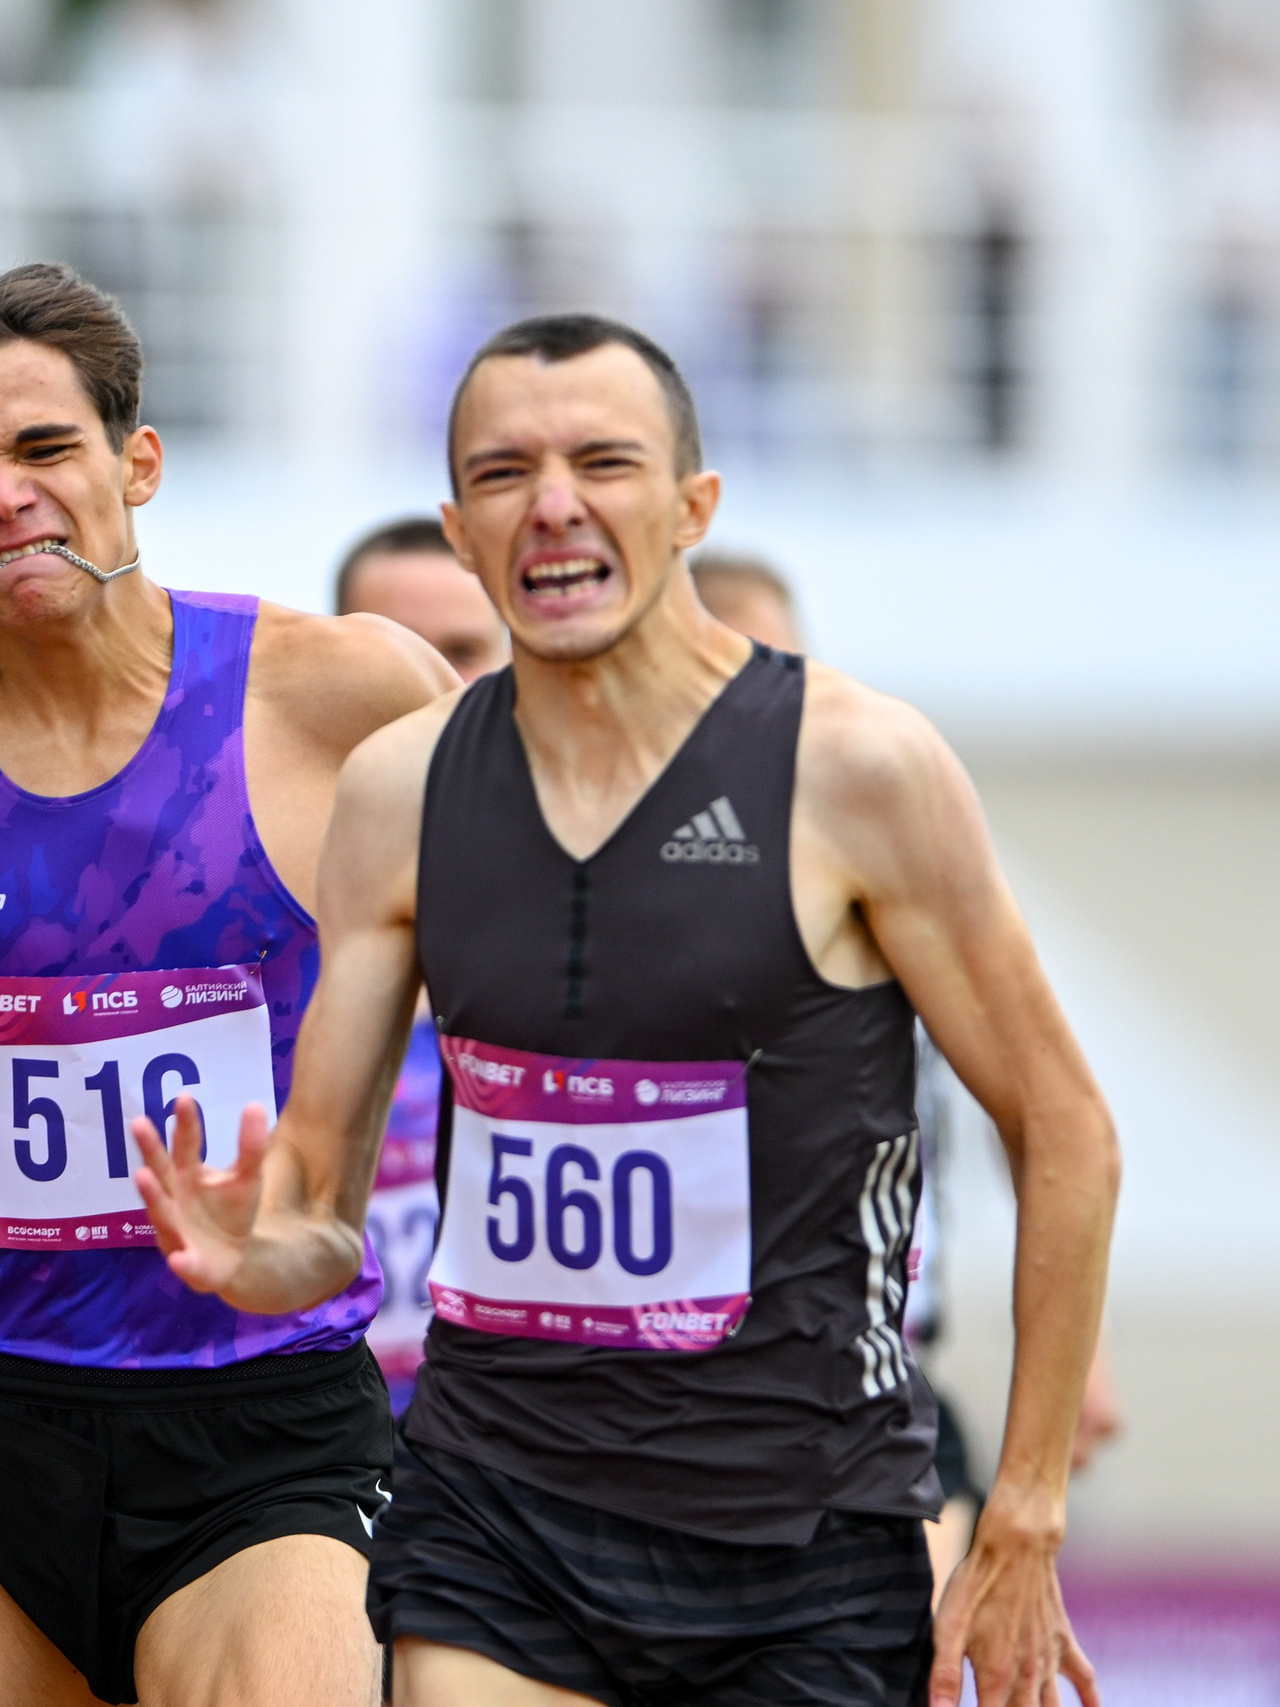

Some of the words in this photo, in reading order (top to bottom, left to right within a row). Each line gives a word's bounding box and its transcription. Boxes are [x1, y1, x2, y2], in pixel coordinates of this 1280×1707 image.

[659, 841, 760, 864] adidas
[185, 981, 248, 993] БАЛТИЙСКИЙ
[185, 989, 248, 1005] ЛИЗИНГ
[92, 990, 138, 1010] ПСБ
[567, 1074, 614, 1096] ПСБ
[12, 1052, 207, 1182] 516
[486, 1132, 673, 1276] 560
[639, 1312, 730, 1332] FONBET
